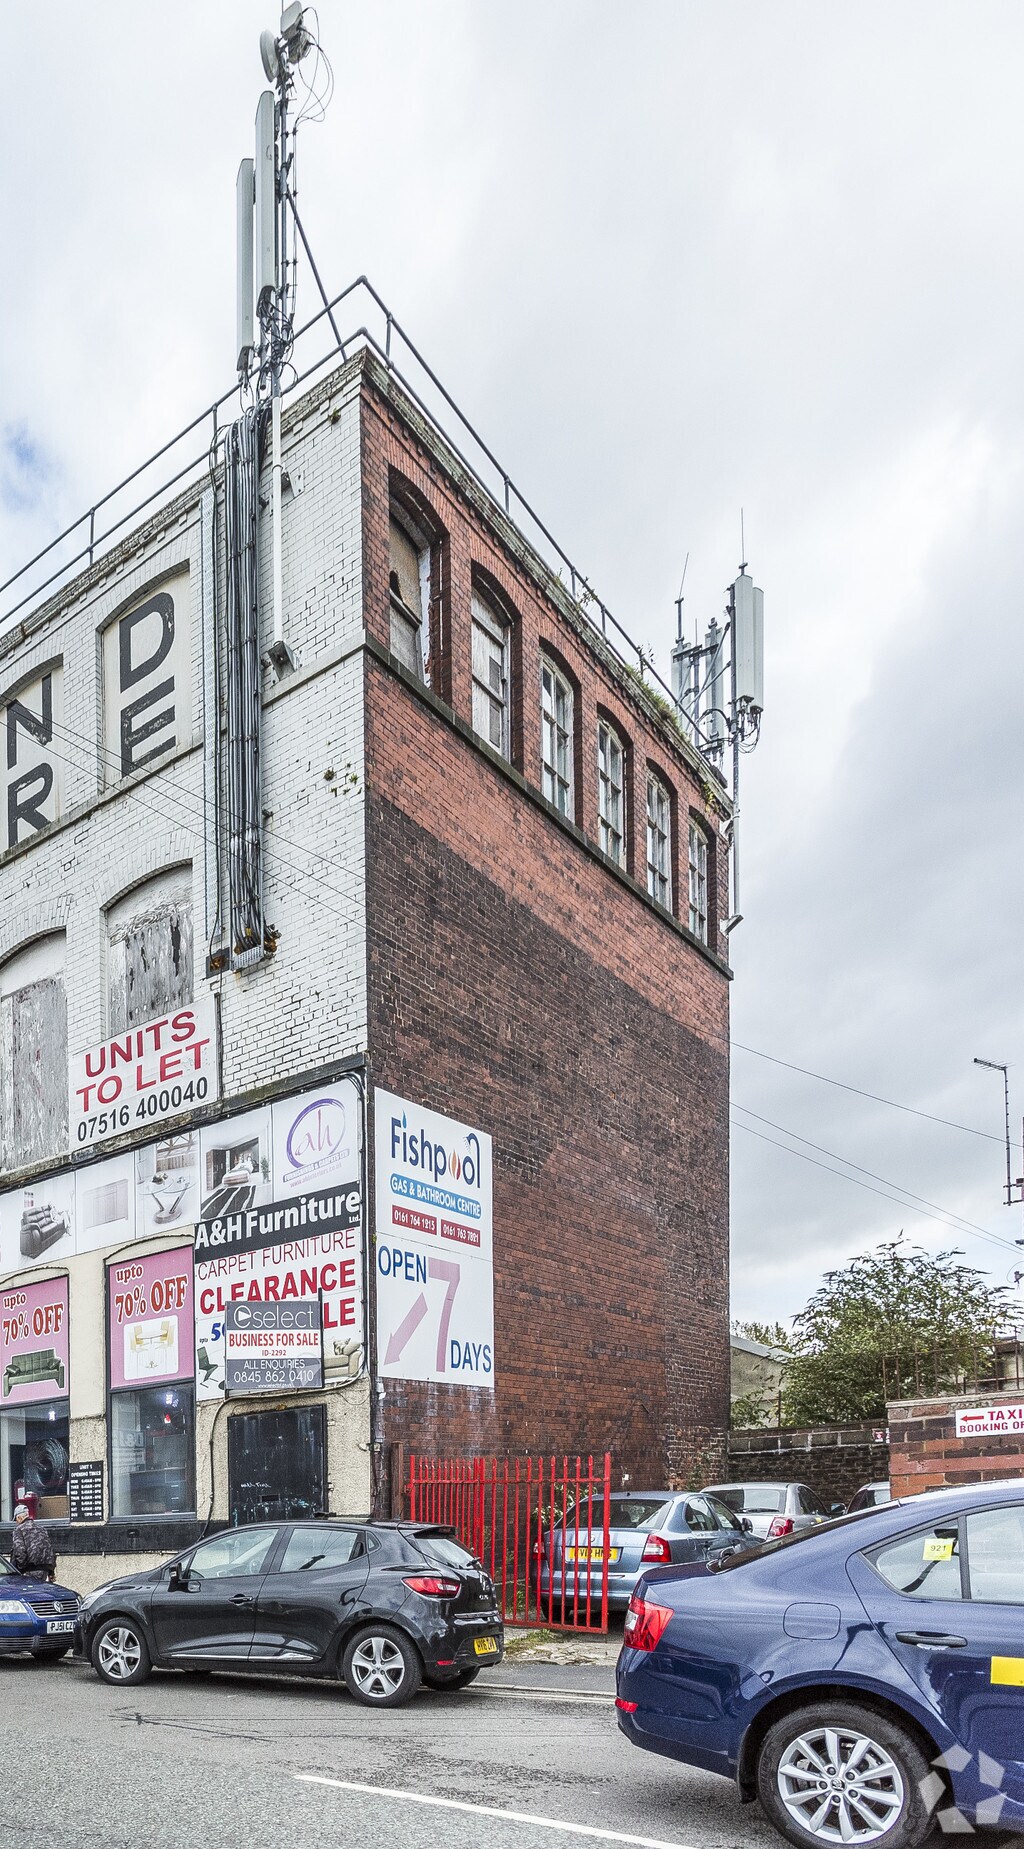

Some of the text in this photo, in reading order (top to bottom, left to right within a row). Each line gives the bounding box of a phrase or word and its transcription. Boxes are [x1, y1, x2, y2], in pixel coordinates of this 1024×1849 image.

[85, 1011, 196, 1077] UNITS
[76, 1038, 210, 1112] TO LET
[78, 1076, 208, 1142] 07516 400040
[391, 1177, 481, 1217] GAS & BATHROOM CENTRE
[195, 1191, 360, 1250] A&H Furniture
[394, 1210, 408, 1223] 0161
[410, 1214, 420, 1227] 764
[443, 1224, 456, 1236] 0161
[457, 1227, 467, 1240] 763
[116, 1264, 143, 1283] upto
[198, 1229, 355, 1280] CARPET FURNITURE
[378, 1245, 427, 1284] OPEN
[4, 1293, 26, 1310] upto
[115, 1276, 187, 1323] 70% OFF
[200, 1259, 356, 1314] CLEARANCE
[3, 1304, 63, 1345] 70% OFF
[428, 1257, 461, 1372] 7
[229, 1332, 319, 1347] BUSINESS FOR SALE
[262, 1349, 286, 1357] ID-2292
[451, 1340, 492, 1373] DAYS
[234, 1370, 314, 1383] 0845 862 0410
[244, 1359, 305, 1370] ALL ENQUIRIES
[959, 1421, 1008, 1433] BOOKING
[987, 1409, 1023, 1421] TAXI
